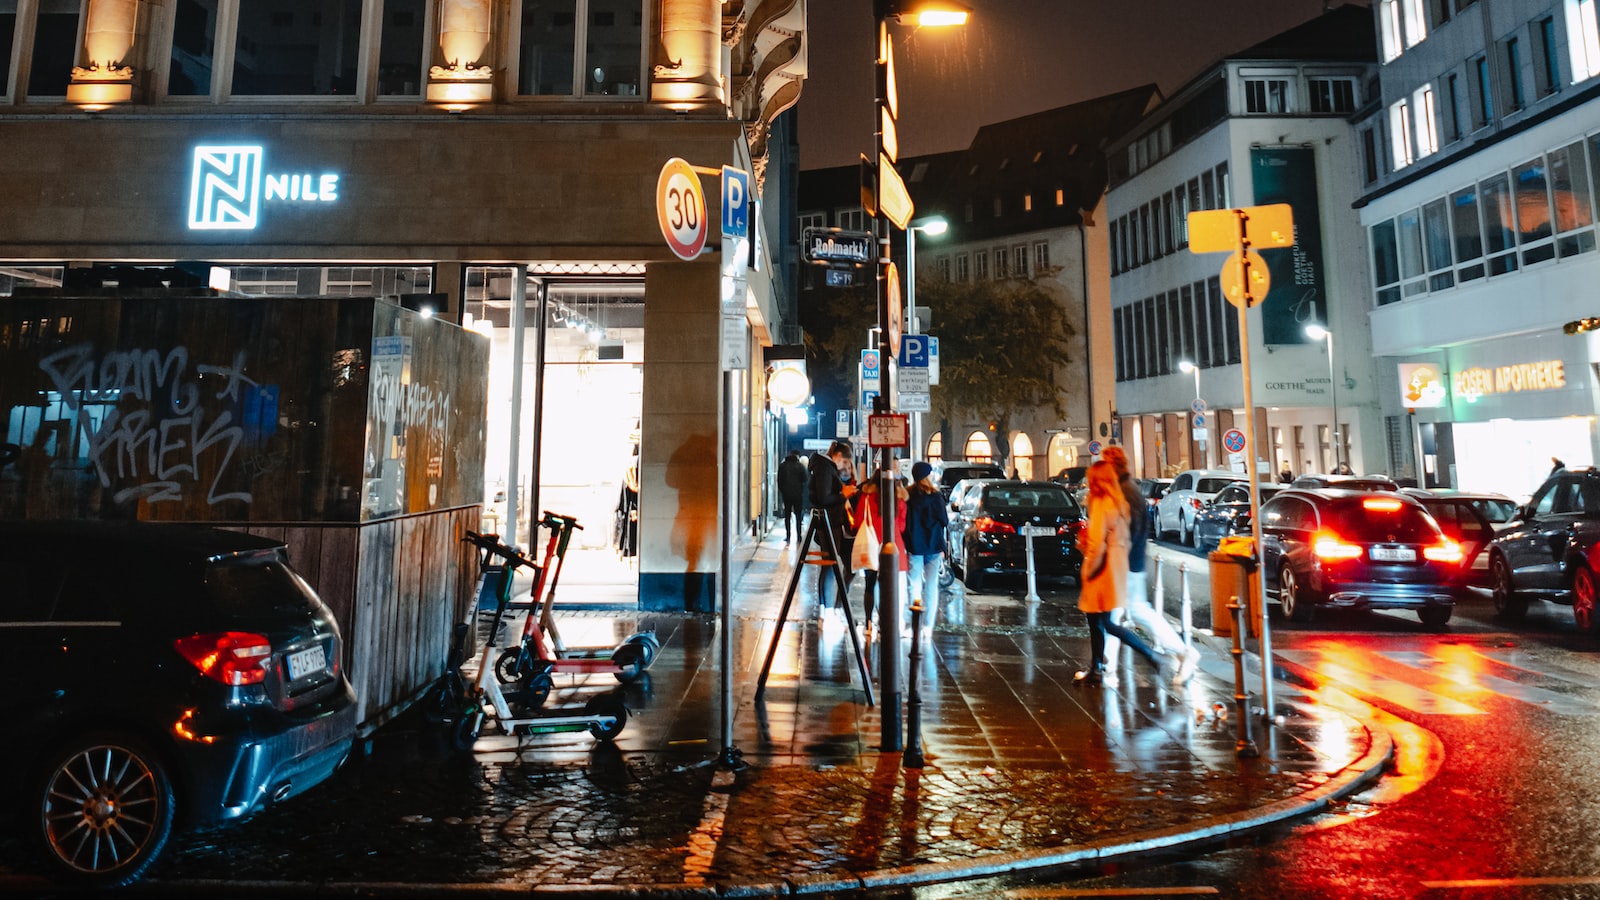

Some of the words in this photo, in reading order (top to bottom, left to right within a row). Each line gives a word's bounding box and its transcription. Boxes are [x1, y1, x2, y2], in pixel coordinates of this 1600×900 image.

[264, 173, 339, 201] NILE
[669, 187, 697, 231] 30
[728, 176, 743, 228] P
[815, 237, 865, 258] Roßmarkt
[905, 338, 922, 364] P
[1265, 382, 1305, 391] GOETHE
[1495, 360, 1566, 392] APOTHEKE
